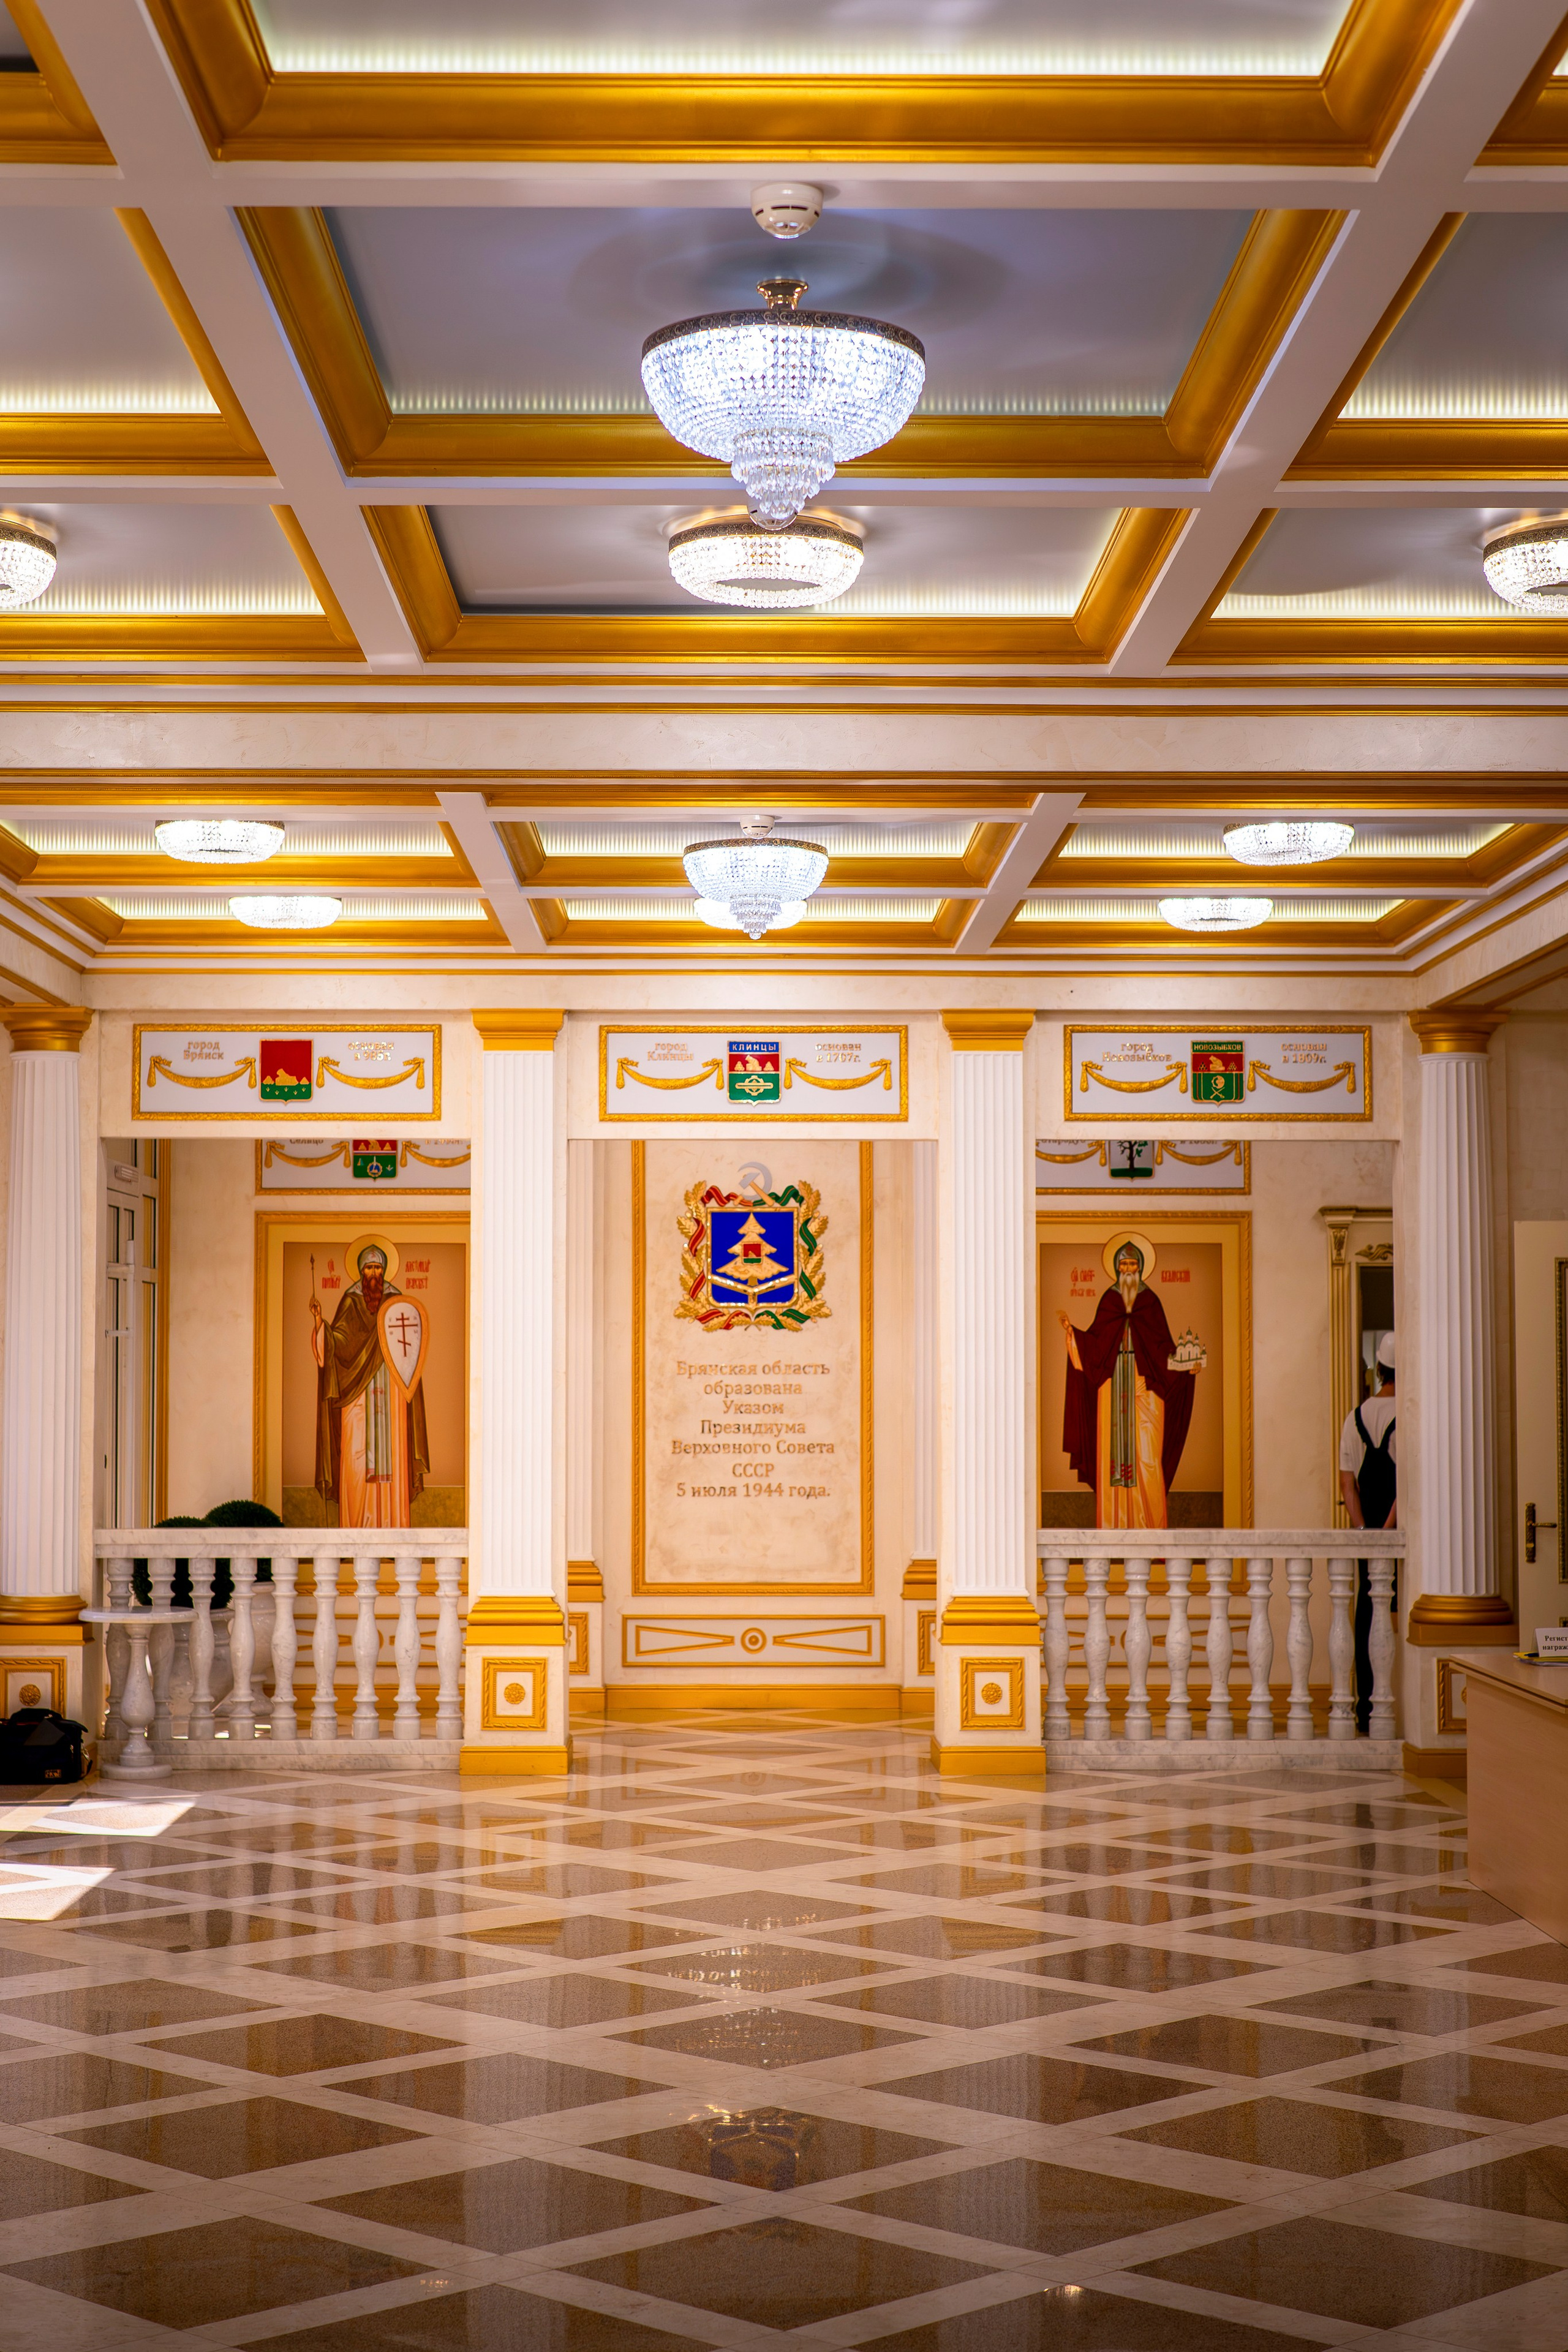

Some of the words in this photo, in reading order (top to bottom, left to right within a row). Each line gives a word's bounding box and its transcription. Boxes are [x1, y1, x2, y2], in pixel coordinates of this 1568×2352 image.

[187, 1041, 220, 1052] город
[348, 1041, 394, 1050] основан
[655, 1042, 687, 1052] город
[1121, 1042, 1153, 1053] город
[184, 1050, 224, 1062] Брянск
[647, 1051, 693, 1062] Клинцы
[827, 1052, 861, 1063] 1707г.
[1102, 1052, 1172, 1062] Новозыбков
[677, 1360, 757, 1378] Брянская
[762, 1360, 831, 1375] область
[704, 1380, 802, 1398] образована
[723, 1400, 784, 1414] Указом
[701, 1420, 806, 1438] Президиума
[672, 1440, 771, 1458] Верховного
[776, 1439, 835, 1454] Совета
[732, 1463, 775, 1477] СССР
[677, 1482, 685, 1497] 5
[692, 1486, 737, 1497] июля
[743, 1482, 783, 1497] 1944
[789, 1486, 831, 1499] года.
